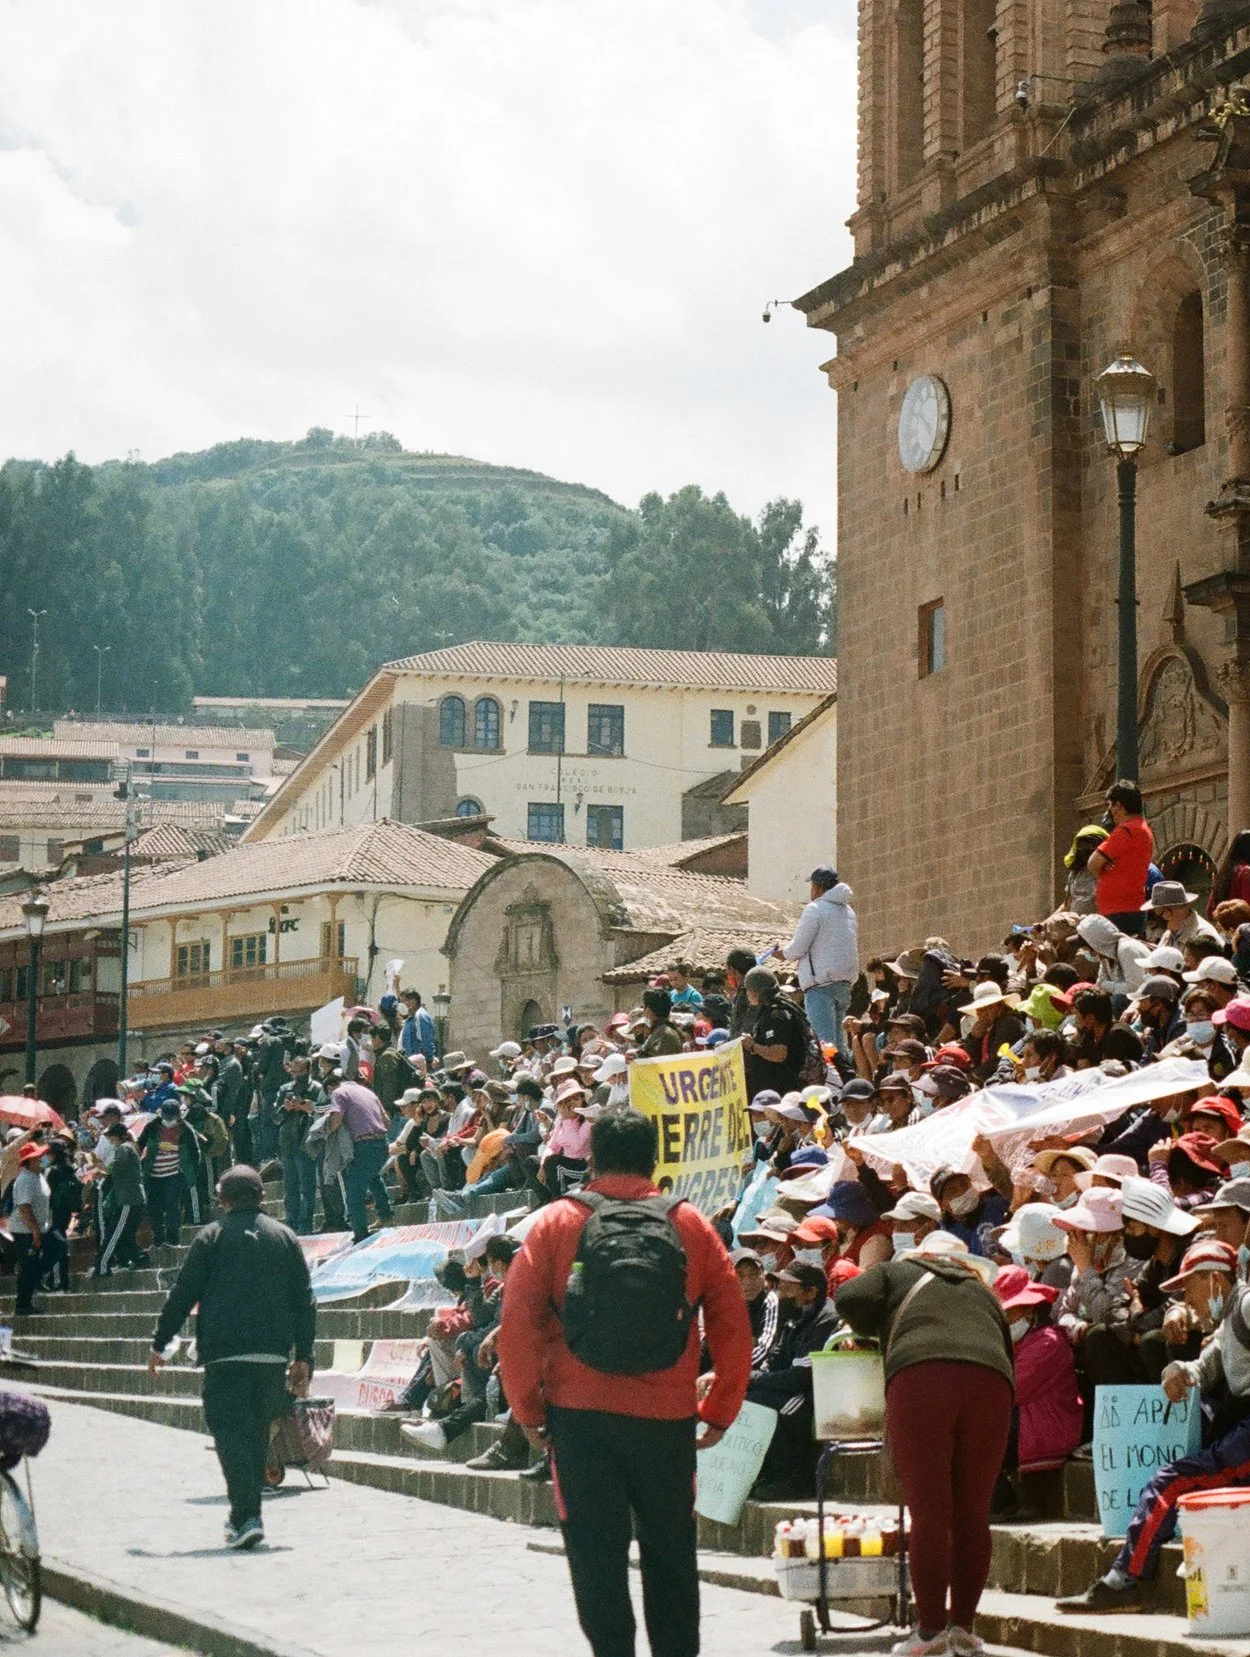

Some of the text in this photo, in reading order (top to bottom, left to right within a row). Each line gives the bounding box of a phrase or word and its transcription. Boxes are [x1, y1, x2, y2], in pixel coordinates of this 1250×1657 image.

[538, 784, 590, 793] FRACISCO
[658, 1060, 738, 1105] URGENTE
[652, 1106, 725, 1164] IERRE
[658, 1165, 740, 1217] ONGRES
[1102, 1444, 1117, 1472] EL
[1102, 1487, 1145, 1511] DE L
